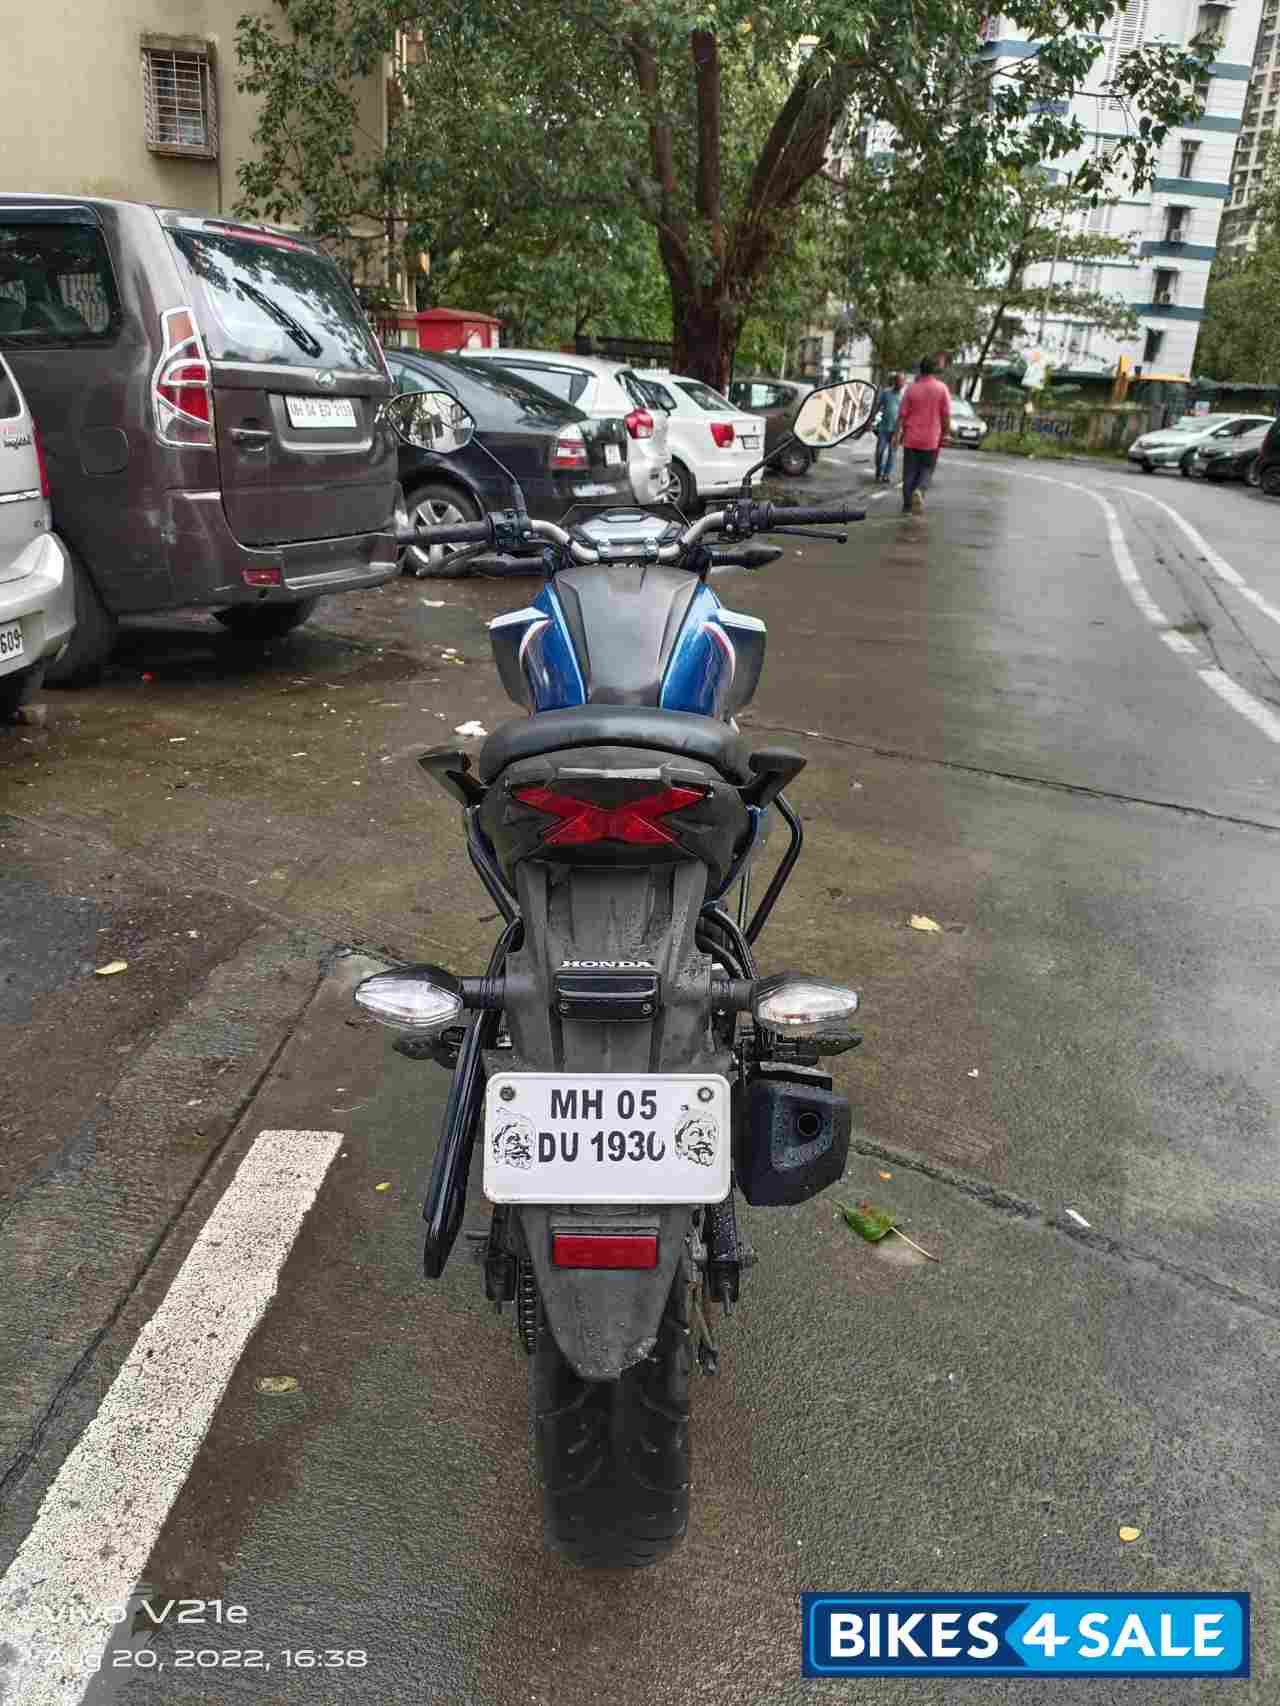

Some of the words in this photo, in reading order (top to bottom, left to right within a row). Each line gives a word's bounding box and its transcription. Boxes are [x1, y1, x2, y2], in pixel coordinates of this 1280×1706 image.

[561, 960, 656, 968] HONDA
[550, 1089, 603, 1120] MH
[616, 1089, 657, 1120] 05
[538, 1132, 579, 1162] DU
